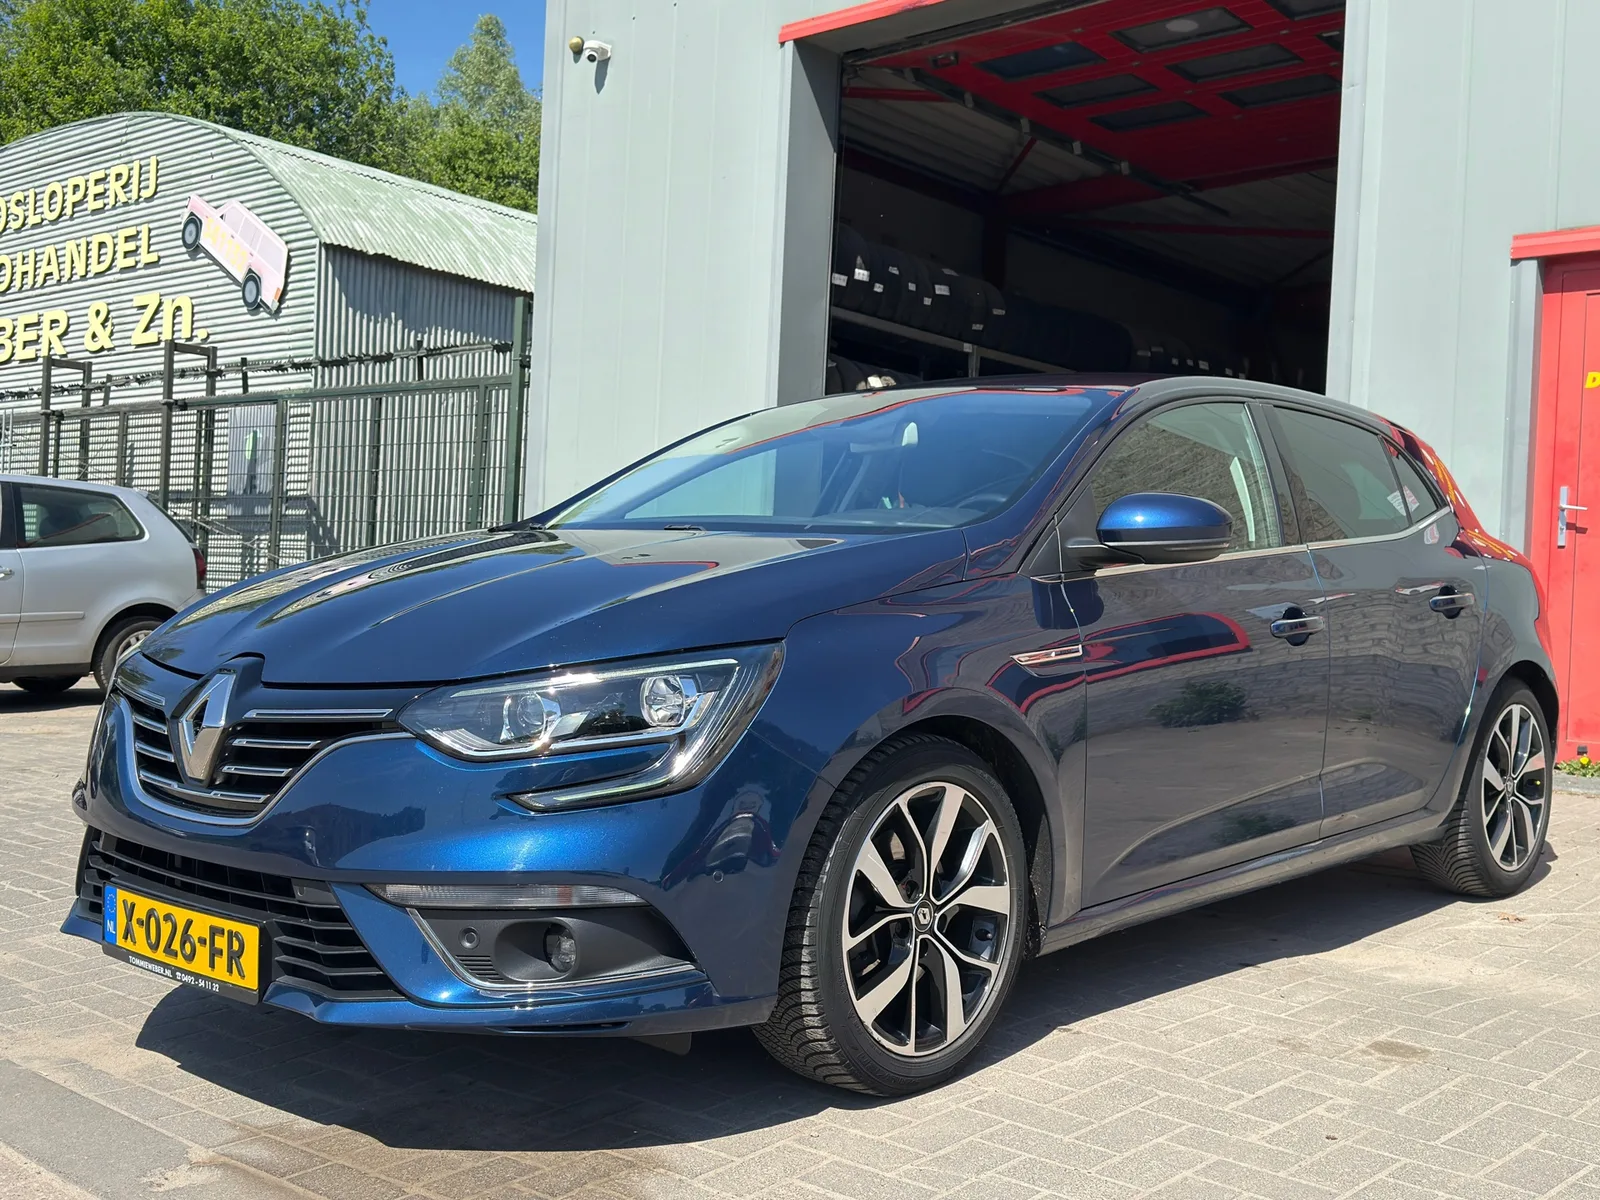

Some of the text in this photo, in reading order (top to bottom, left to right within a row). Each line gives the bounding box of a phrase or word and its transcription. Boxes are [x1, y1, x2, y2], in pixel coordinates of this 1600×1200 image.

[84, 301, 115, 351] &
[131, 292, 209, 345] Zn.
[106, 919, 116, 934] NL
[121, 899, 246, 980] X-026-FR
[128, 955, 173, 977] TOMMIEWEBER.NL
